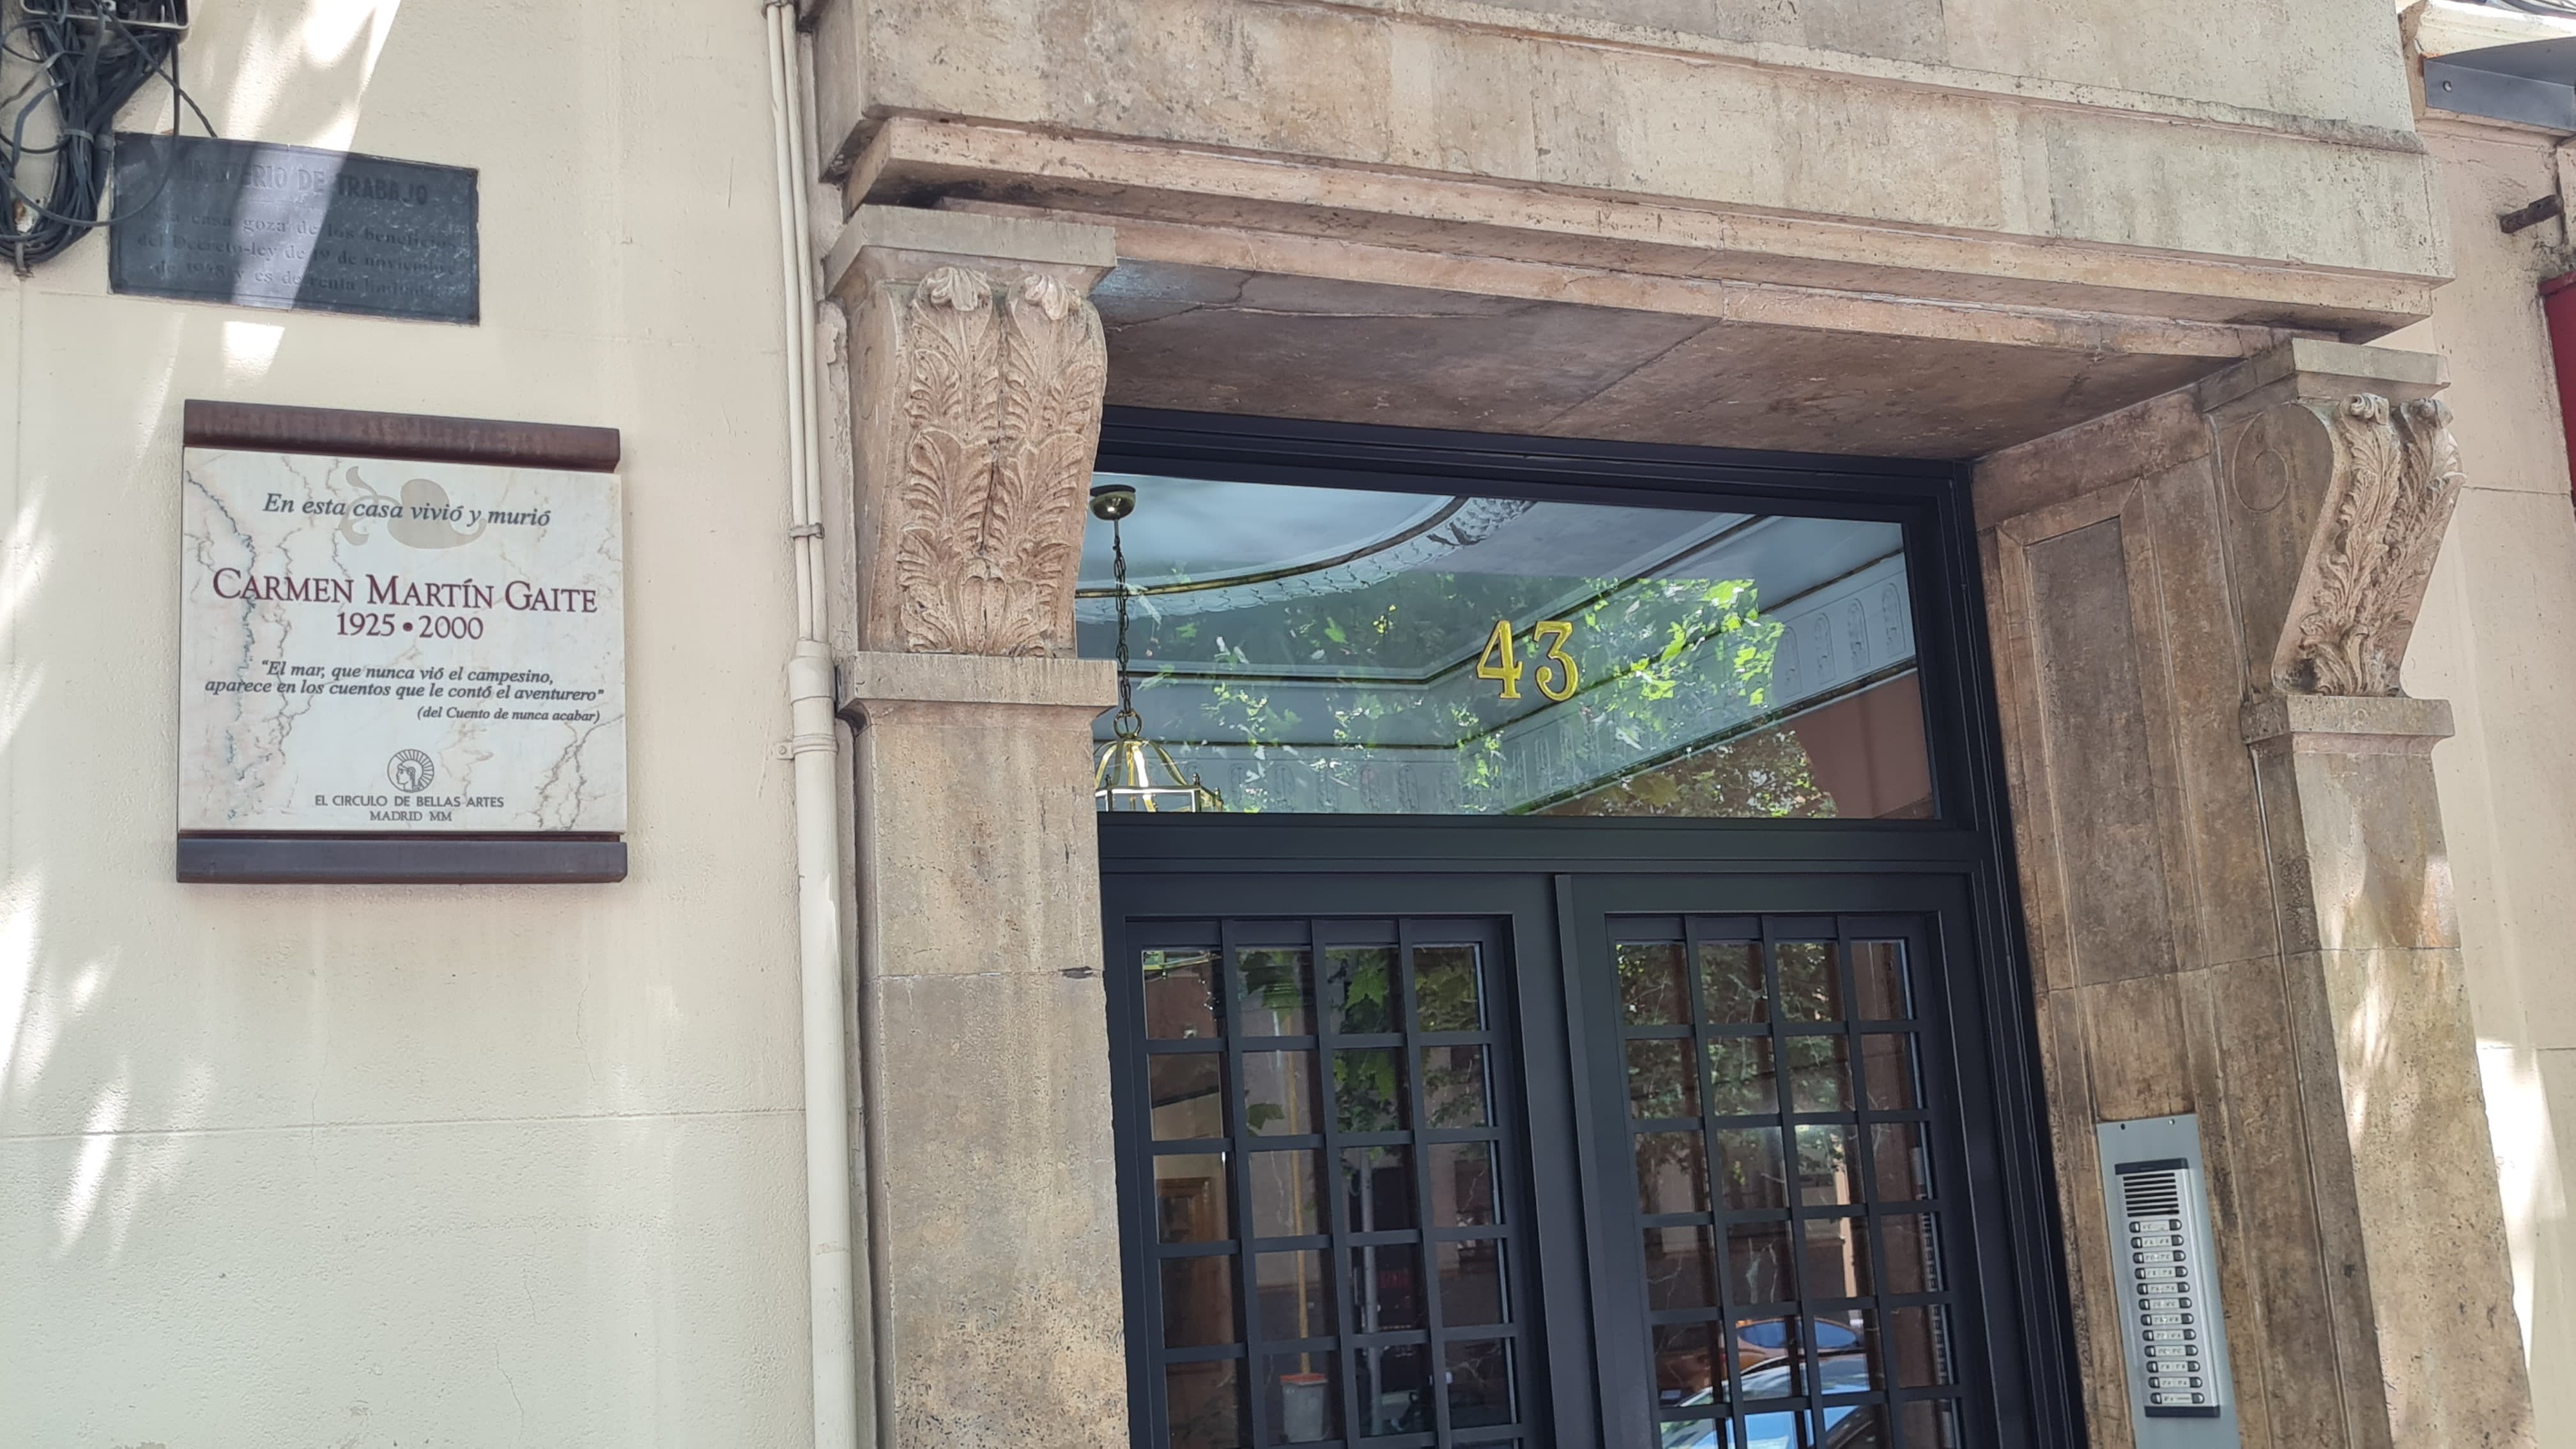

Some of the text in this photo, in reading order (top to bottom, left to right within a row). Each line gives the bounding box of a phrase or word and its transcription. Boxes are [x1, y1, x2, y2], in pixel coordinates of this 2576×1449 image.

[169, 158, 428, 205] INISTERIO DE TRABAJO
[243, 218, 286, 233] goza
[296, 220, 318, 235] de
[328, 224, 355, 240] los
[172, 235, 277, 262] Decreto-ley
[284, 245, 307, 260] de
[337, 250, 356, 265] de
[254, 270, 273, 284] es
[281, 270, 302, 285] de
[263, 492, 552, 527] En esta casa vivió y murió
[213, 567, 598, 613] CARMEN MARTÍN GAITE
[262, 659, 553, 686] “El mar, que nunca vió el campesino,
[1476, 620, 1579, 702] 43
[204, 680, 272, 696] aparece
[276, 682, 296, 694] en
[300, 679, 325, 694] los
[329, 683, 392, 696] cuentos
[395, 686, 425, 700] que
[429, 682, 444, 698] le
[448, 686, 493, 699] contó
[496, 684, 512, 700] el
[417, 706, 601, 724] (del Cuento de nunca acabar)
[314, 794, 504, 808] EL CIRCULO DE BELLAS ARTES
[369, 810, 452, 822] MADRID MM
